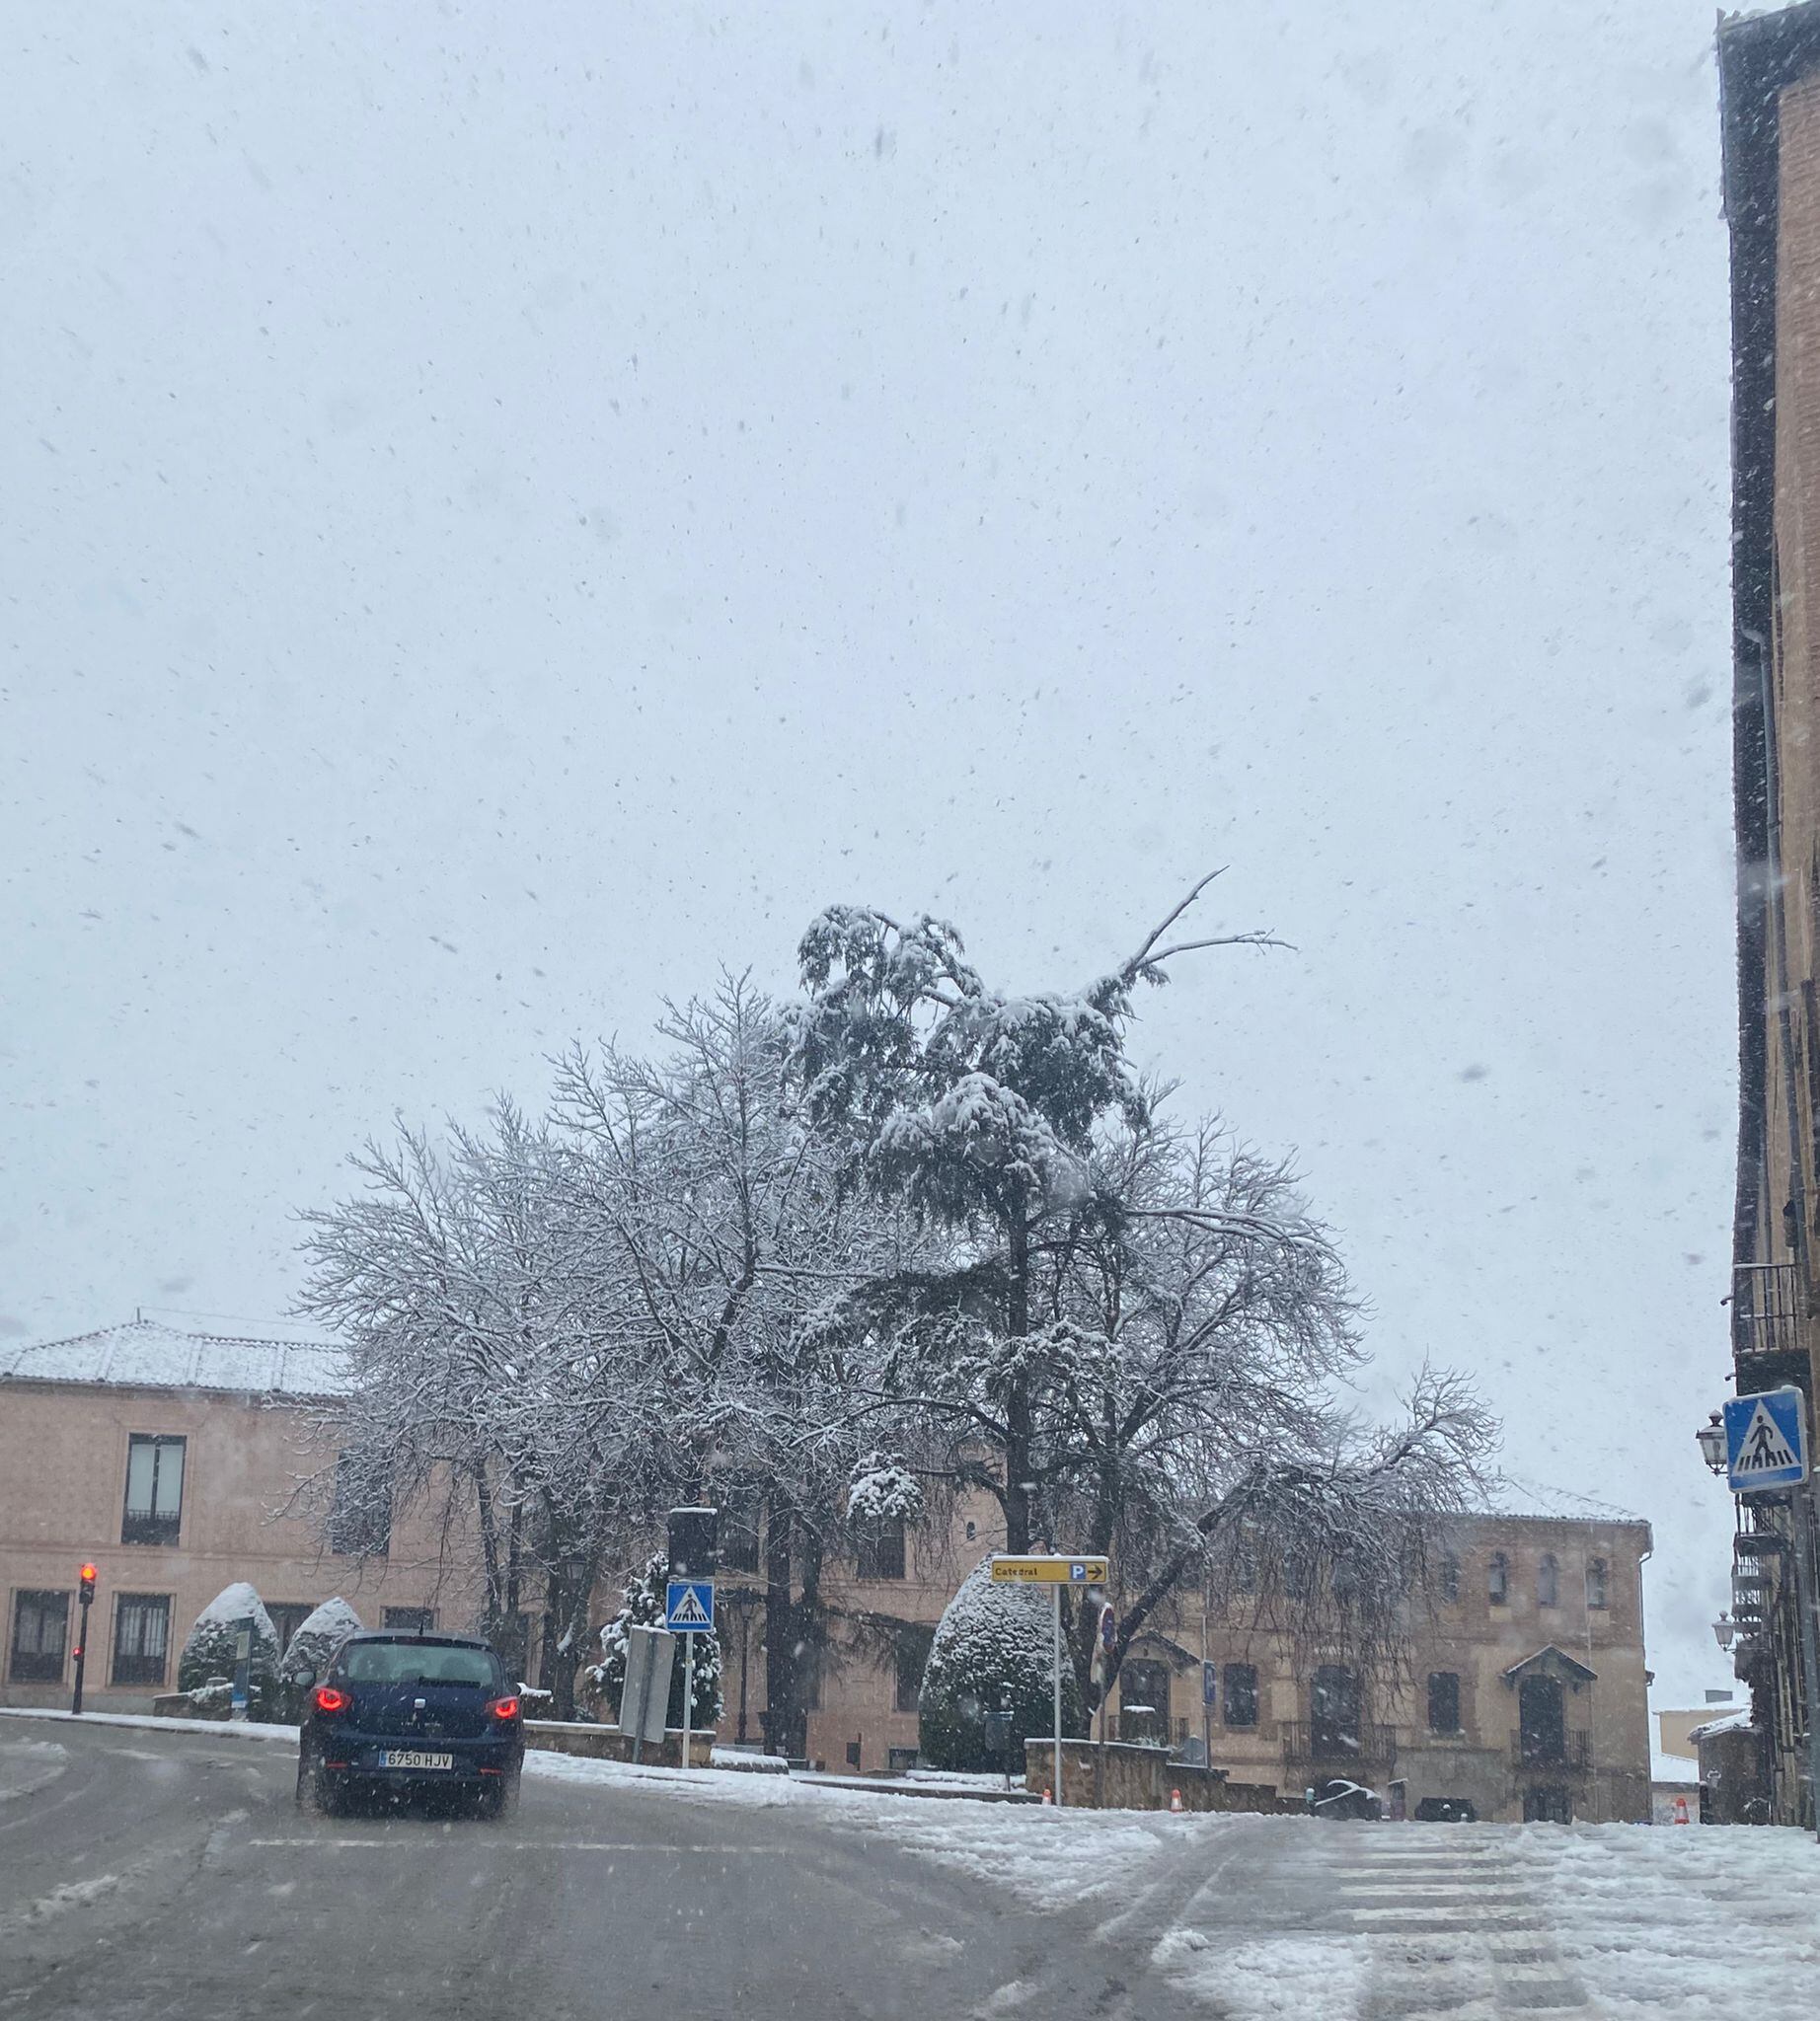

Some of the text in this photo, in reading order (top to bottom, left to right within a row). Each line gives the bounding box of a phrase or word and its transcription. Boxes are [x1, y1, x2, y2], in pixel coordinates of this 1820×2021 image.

[995, 1565, 1084, 1579] Catedral P
[388, 1754, 449, 1767] 6750 HJV
